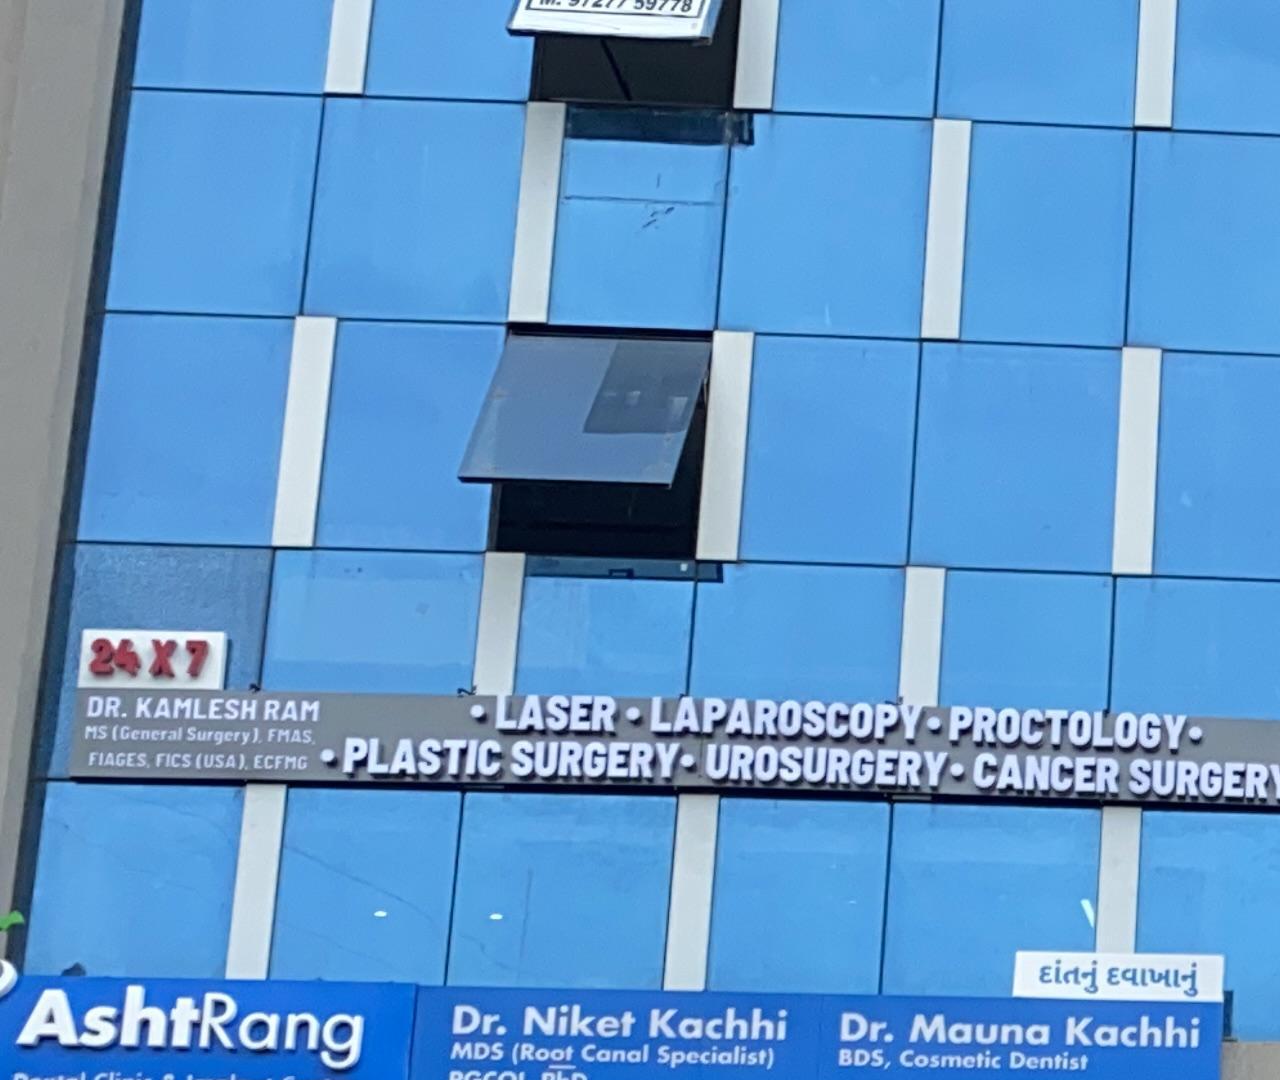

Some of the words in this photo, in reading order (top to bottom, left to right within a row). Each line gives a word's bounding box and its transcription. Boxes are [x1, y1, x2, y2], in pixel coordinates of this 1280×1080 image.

[89, 638, 141, 677] 24
[150, 639, 177, 677] X
[186, 640, 208, 677] 7
[86, 696, 128, 718] DR.
[135, 697, 256, 720] KAMLESH
[263, 699, 320, 722] RAM
[495, 696, 616, 733] LASER
[650, 696, 923, 740] LAPAROSCOPY
[948, 705, 1187, 750] PROCTOLOGY
[84, 725, 108, 739] MS
[112, 725, 183, 742] (General
[155, 753, 191, 768] FICS
[253, 755, 308, 770] ECFMG
[342, 737, 502, 777] PLASTIC
[510, 740, 681, 780] SURGERY
[706, 744, 950, 787] UROSURGERY
[972, 752, 1119, 794] CANCER
[16, 984, 365, 1070] AshtRang
[452, 1005, 507, 1035] Dr.
[523, 1004, 636, 1038] Niket
[648, 1007, 788, 1041] Kachhi
[839, 1012, 894, 1043] Dr.
[909, 1014, 1050, 1046] Mauna
[1065, 1016, 1200, 1049] Kachhi
[450, 1043, 503, 1060] MDS
[511, 1043, 574, 1065] (Root
[581, 1044, 648, 1064] Canal
[657, 1046, 774, 1070] Specialist)
[838, 1049, 891, 1070] BDS,
[899, 1050, 1001, 1070] Cosmetic
[1009, 1052, 1088, 1071] Dentist
